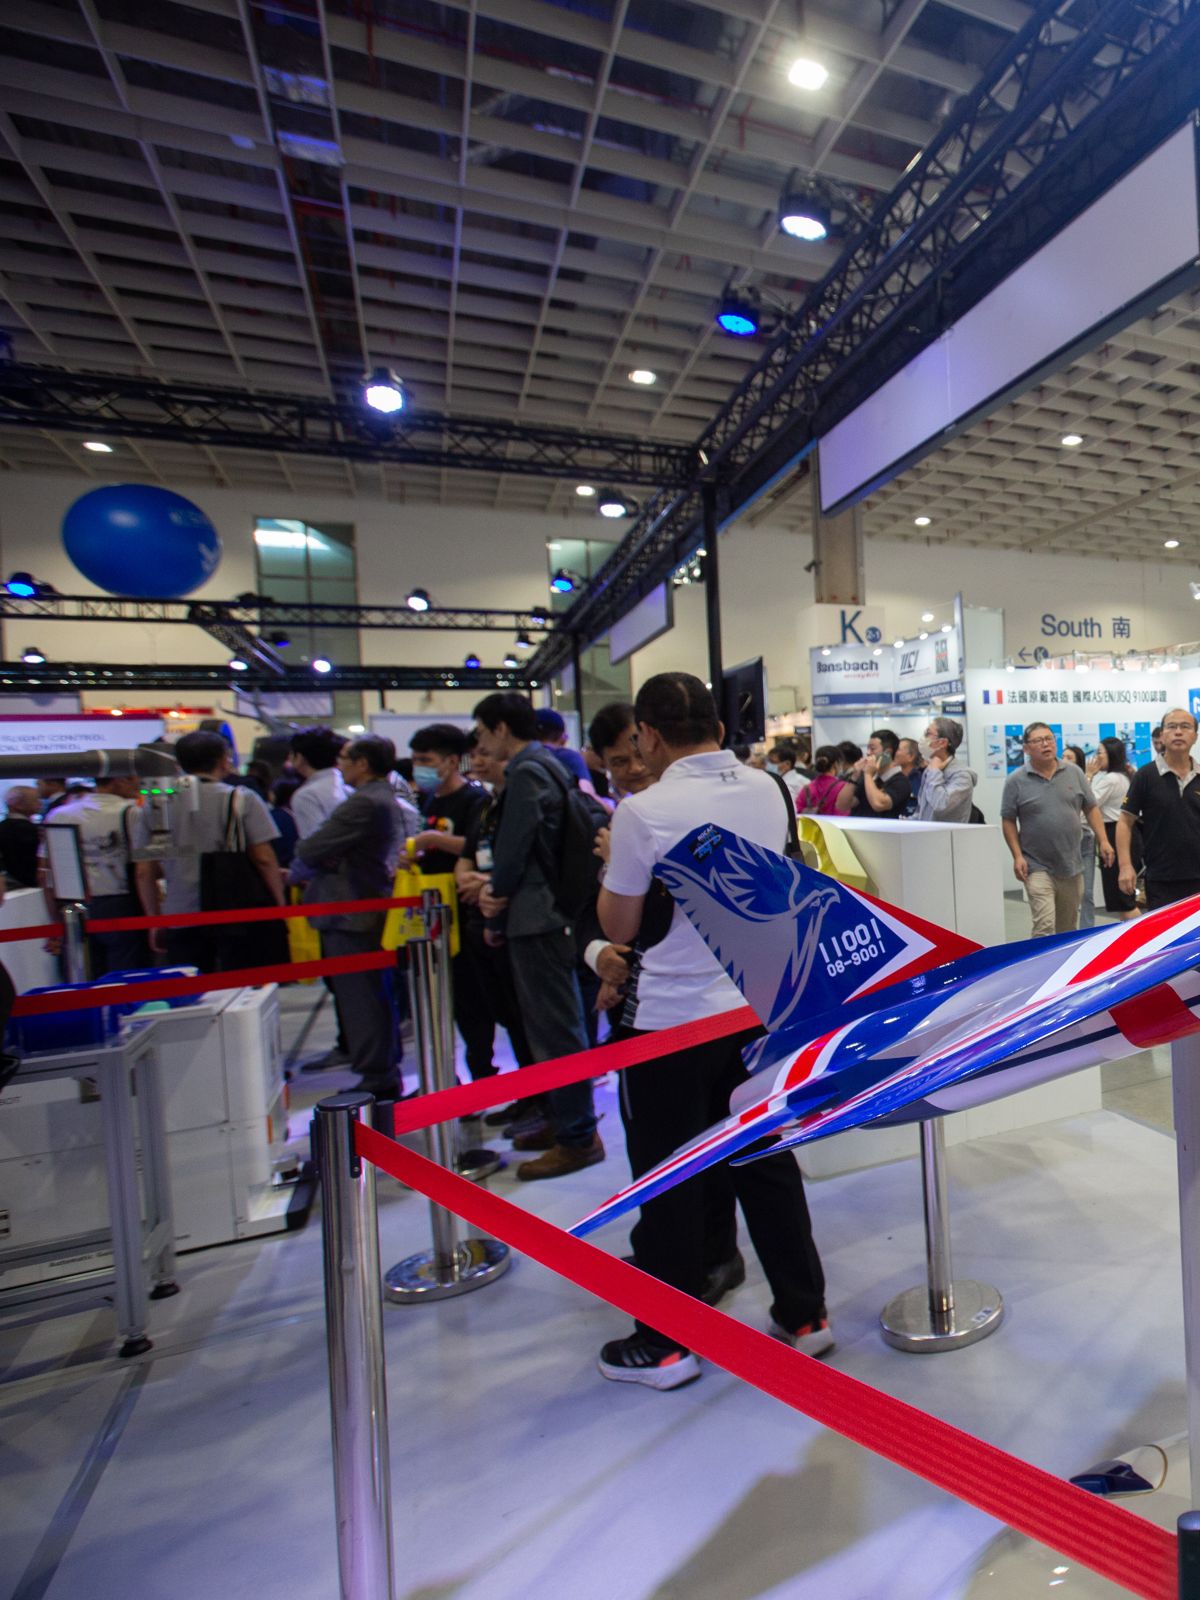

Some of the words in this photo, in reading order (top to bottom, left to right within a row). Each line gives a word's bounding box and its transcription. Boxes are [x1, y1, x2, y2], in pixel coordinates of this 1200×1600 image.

[840, 609, 864, 644] K
[1041, 613, 1102, 639] South
[1112, 616, 1131, 639] 南
[826, 940, 886, 977] 08-9001
